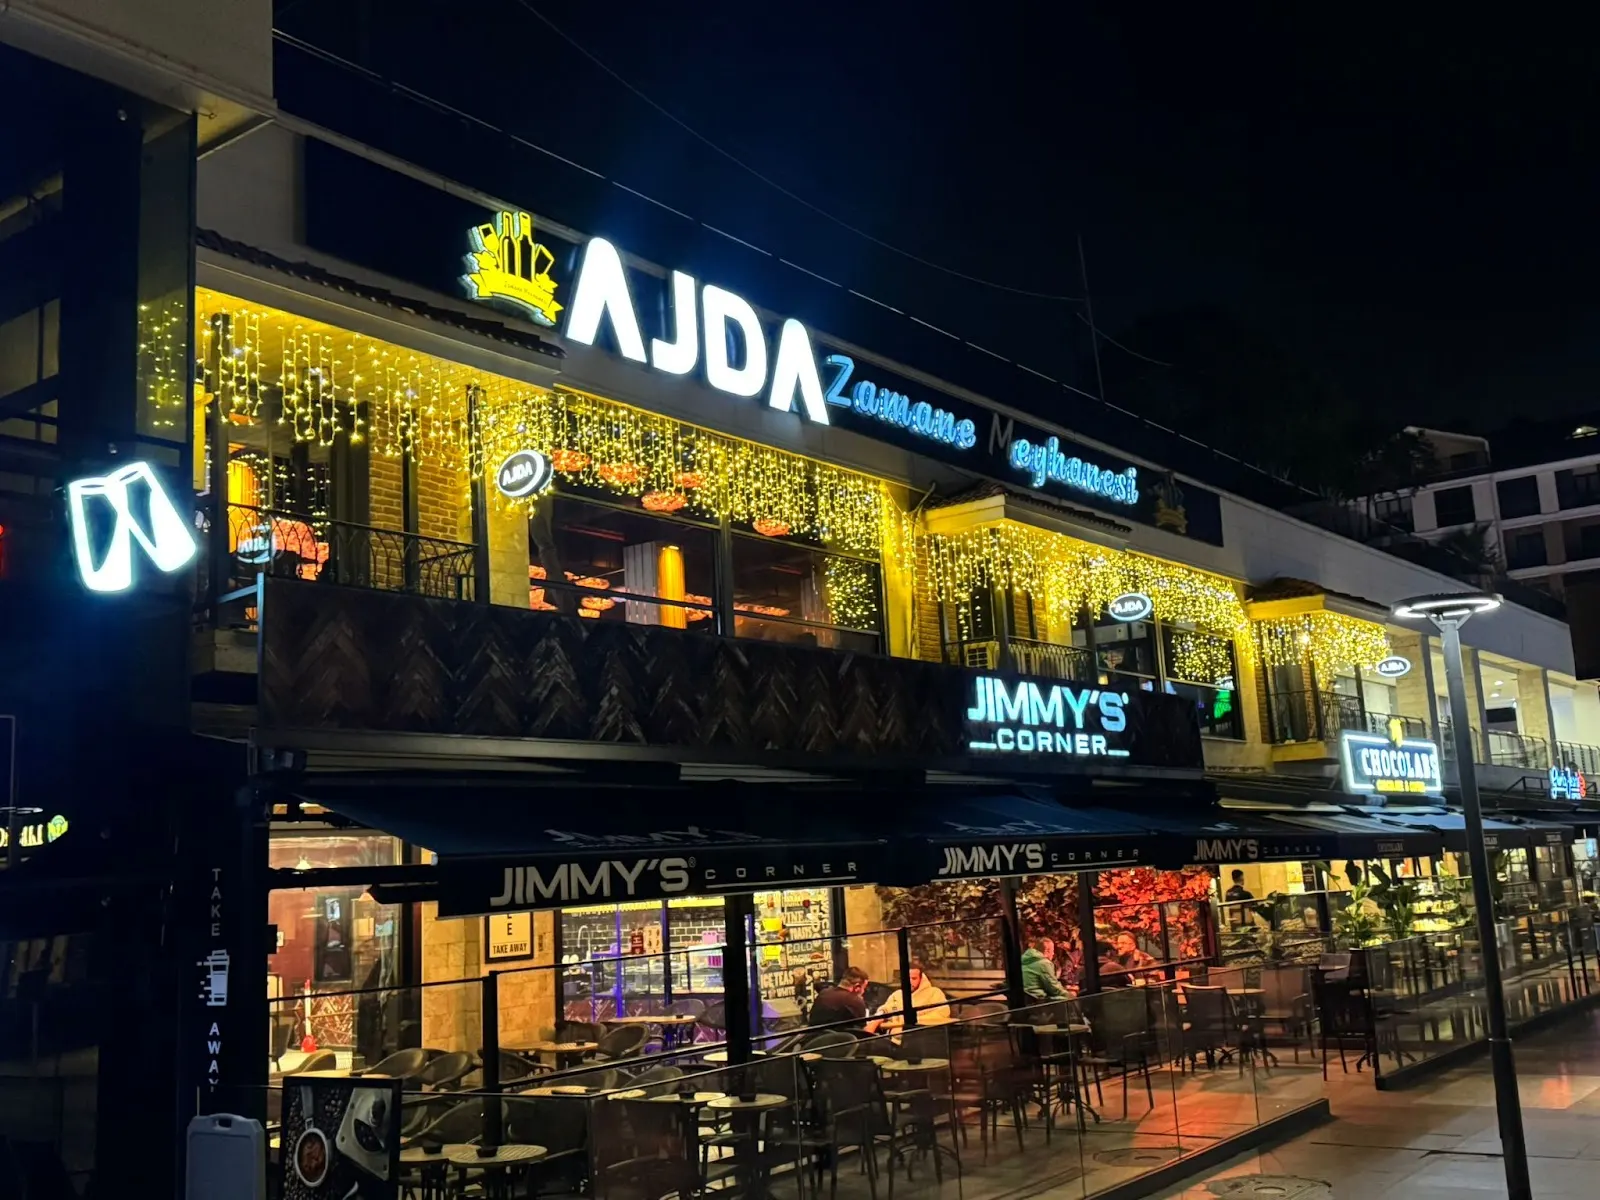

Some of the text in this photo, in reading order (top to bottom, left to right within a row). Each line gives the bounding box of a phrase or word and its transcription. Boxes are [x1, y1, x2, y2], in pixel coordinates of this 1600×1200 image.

[566, 237, 829, 426] AJDA
[826, 355, 1139, 505] Zamane Meyhanesi
[502, 461, 533, 486] AJDA
[1115, 600, 1144, 613] AJDA
[997, 728, 1107, 756] CORNER
[704, 862, 857, 880] CORNER
[938, 843, 1140, 875] JIMMY'S CORNER
[211, 868, 222, 936] TAKE
[493, 943, 527, 954] TAKE AWAY
[207, 1022, 221, 1092] AWAY
